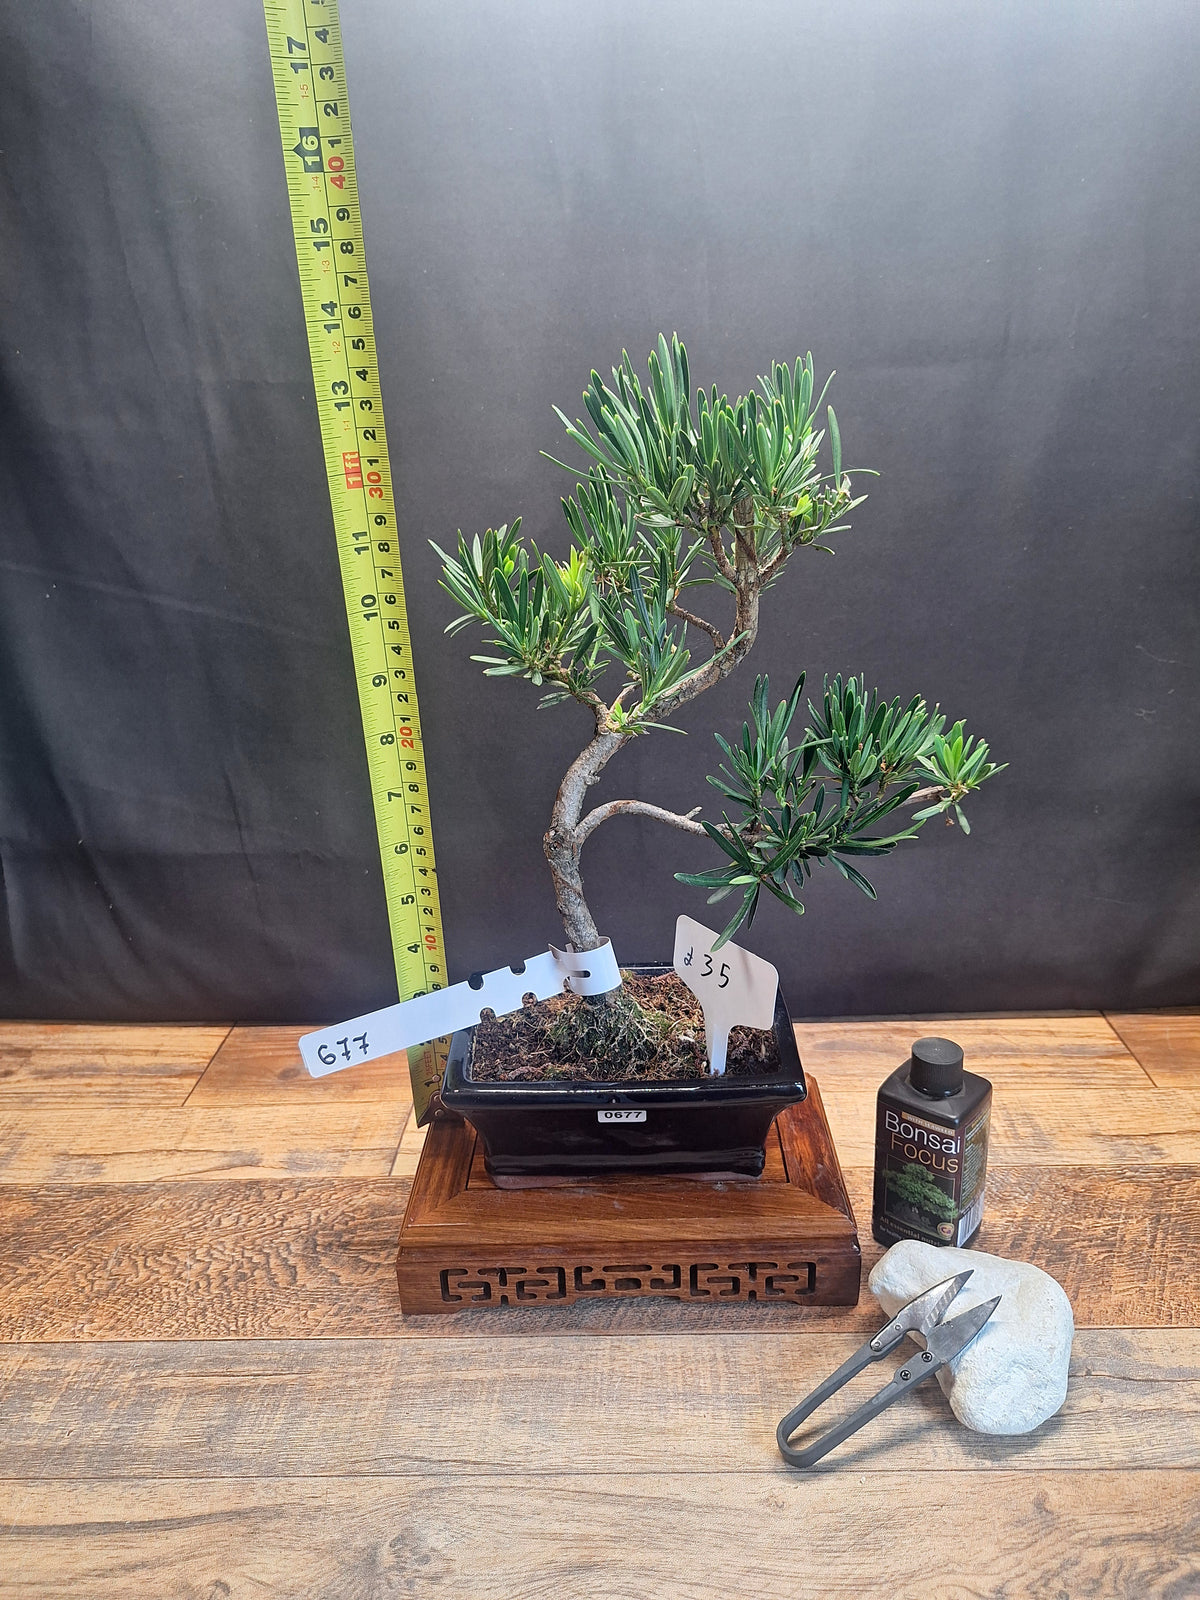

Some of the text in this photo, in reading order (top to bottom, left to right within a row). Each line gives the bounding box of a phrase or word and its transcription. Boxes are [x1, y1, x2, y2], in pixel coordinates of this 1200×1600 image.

[315, 28, 329, 43] 4
[287, 36, 309, 74] 17
[320, 66, 334, 80] 3
[324, 102, 338, 116] 2
[328, 139, 342, 148] 1
[302, 135, 320, 166] 16
[328, 156, 345, 189] 40
[336, 208, 350, 222] 9
[310, 218, 330, 251] 15
[340, 241, 354, 254] 8
[344, 275, 358, 287] 7
[321, 301, 340, 333] 14
[348, 307, 361, 319] 6
[352, 338, 365, 350] 5
[356, 369, 368, 381] 4
[332, 380, 350, 412] 13
[360, 400, 372, 410] 3
[364, 430, 376, 440] 2
[367, 472, 383, 498] 30
[375, 516, 386, 526] 9
[352, 532, 369, 555] 11
[378, 542, 390, 552] 8
[382, 569, 393, 578] 7
[385, 594, 396, 604] 6
[361, 594, 378, 621] 10
[388, 620, 400, 630] 5
[391, 646, 402, 655] 4
[394, 670, 406, 679] 3
[372, 674, 387, 687] 9
[398, 694, 408, 703] 2
[380, 734, 394, 745] 8
[400, 726, 414, 748] 20
[406, 762, 416, 770] 9
[409, 784, 419, 792] 8
[388, 791, 402, 802] 7
[414, 827, 424, 835] 6
[394, 844, 408, 854] 6
[416, 848, 426, 856] 5
[419, 868, 428, 876] 4
[421, 888, 430, 896] 3
[402, 895, 414, 905] 5
[423, 908, 432, 916] 2
[425, 935, 436, 950] 10
[408, 944, 420, 953] 4
[317, 1032, 370, 1065] 677
[604, 1111, 642, 1119] 0677
[885, 1110, 961, 1154] Bonsai
[891, 1132, 959, 1173] Focus
